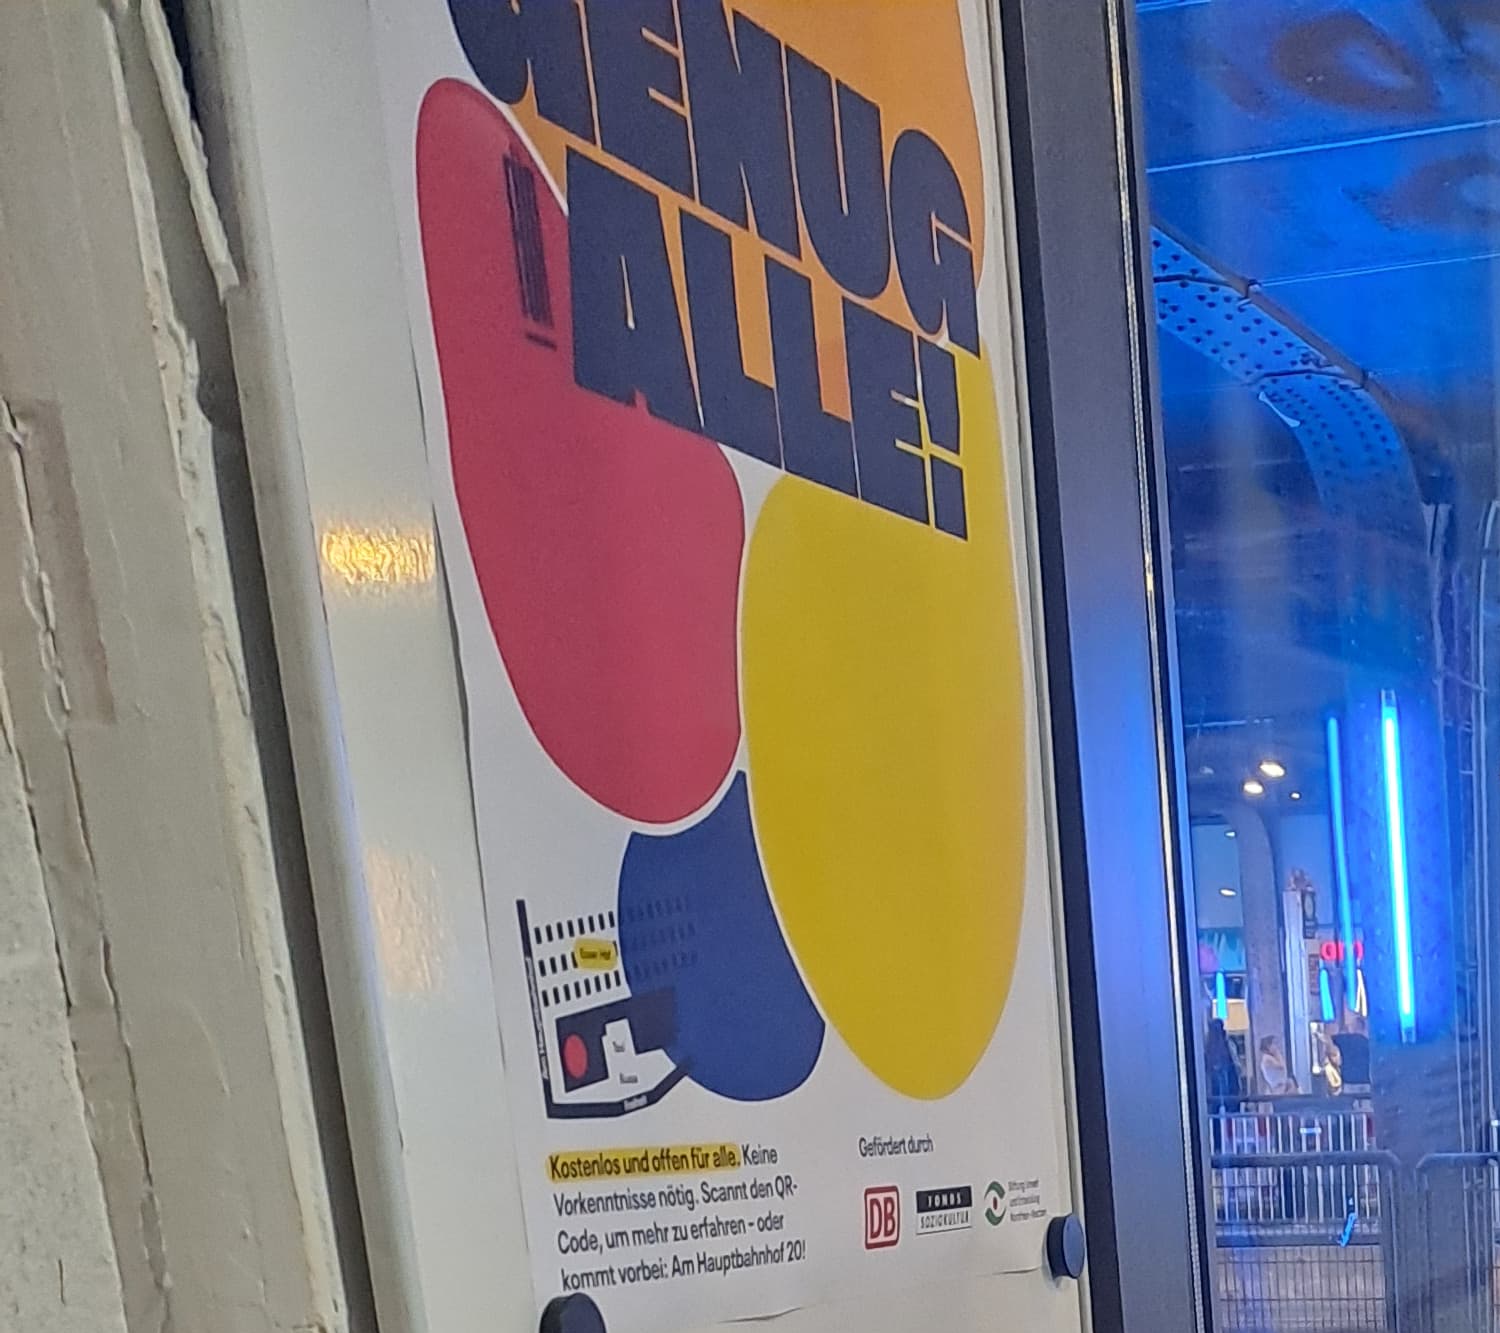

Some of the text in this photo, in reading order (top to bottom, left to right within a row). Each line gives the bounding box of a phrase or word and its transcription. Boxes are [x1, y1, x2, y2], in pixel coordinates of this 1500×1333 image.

[565, 145, 968, 542] ALLE!
[550, 1144, 778, 1179] Kostenlos und offen für alle. Keine
[859, 1134, 934, 1157] Gefördert durch
[553, 1175, 798, 1216] Vorkenntnisse nötig. Scannt den QR-
[558, 1228, 603, 1254] Code,
[605, 1233, 630, 1249] um
[632, 1223, 669, 1245] mehr
[672, 1224, 689, 1242] zu
[691, 1214, 746, 1240] erfahren
[756, 1211, 784, 1232] oder
[870, 1197, 895, 1239] DB
[561, 1239, 807, 1291] kommt vorbei: Am Hauptbahnhof 20!
